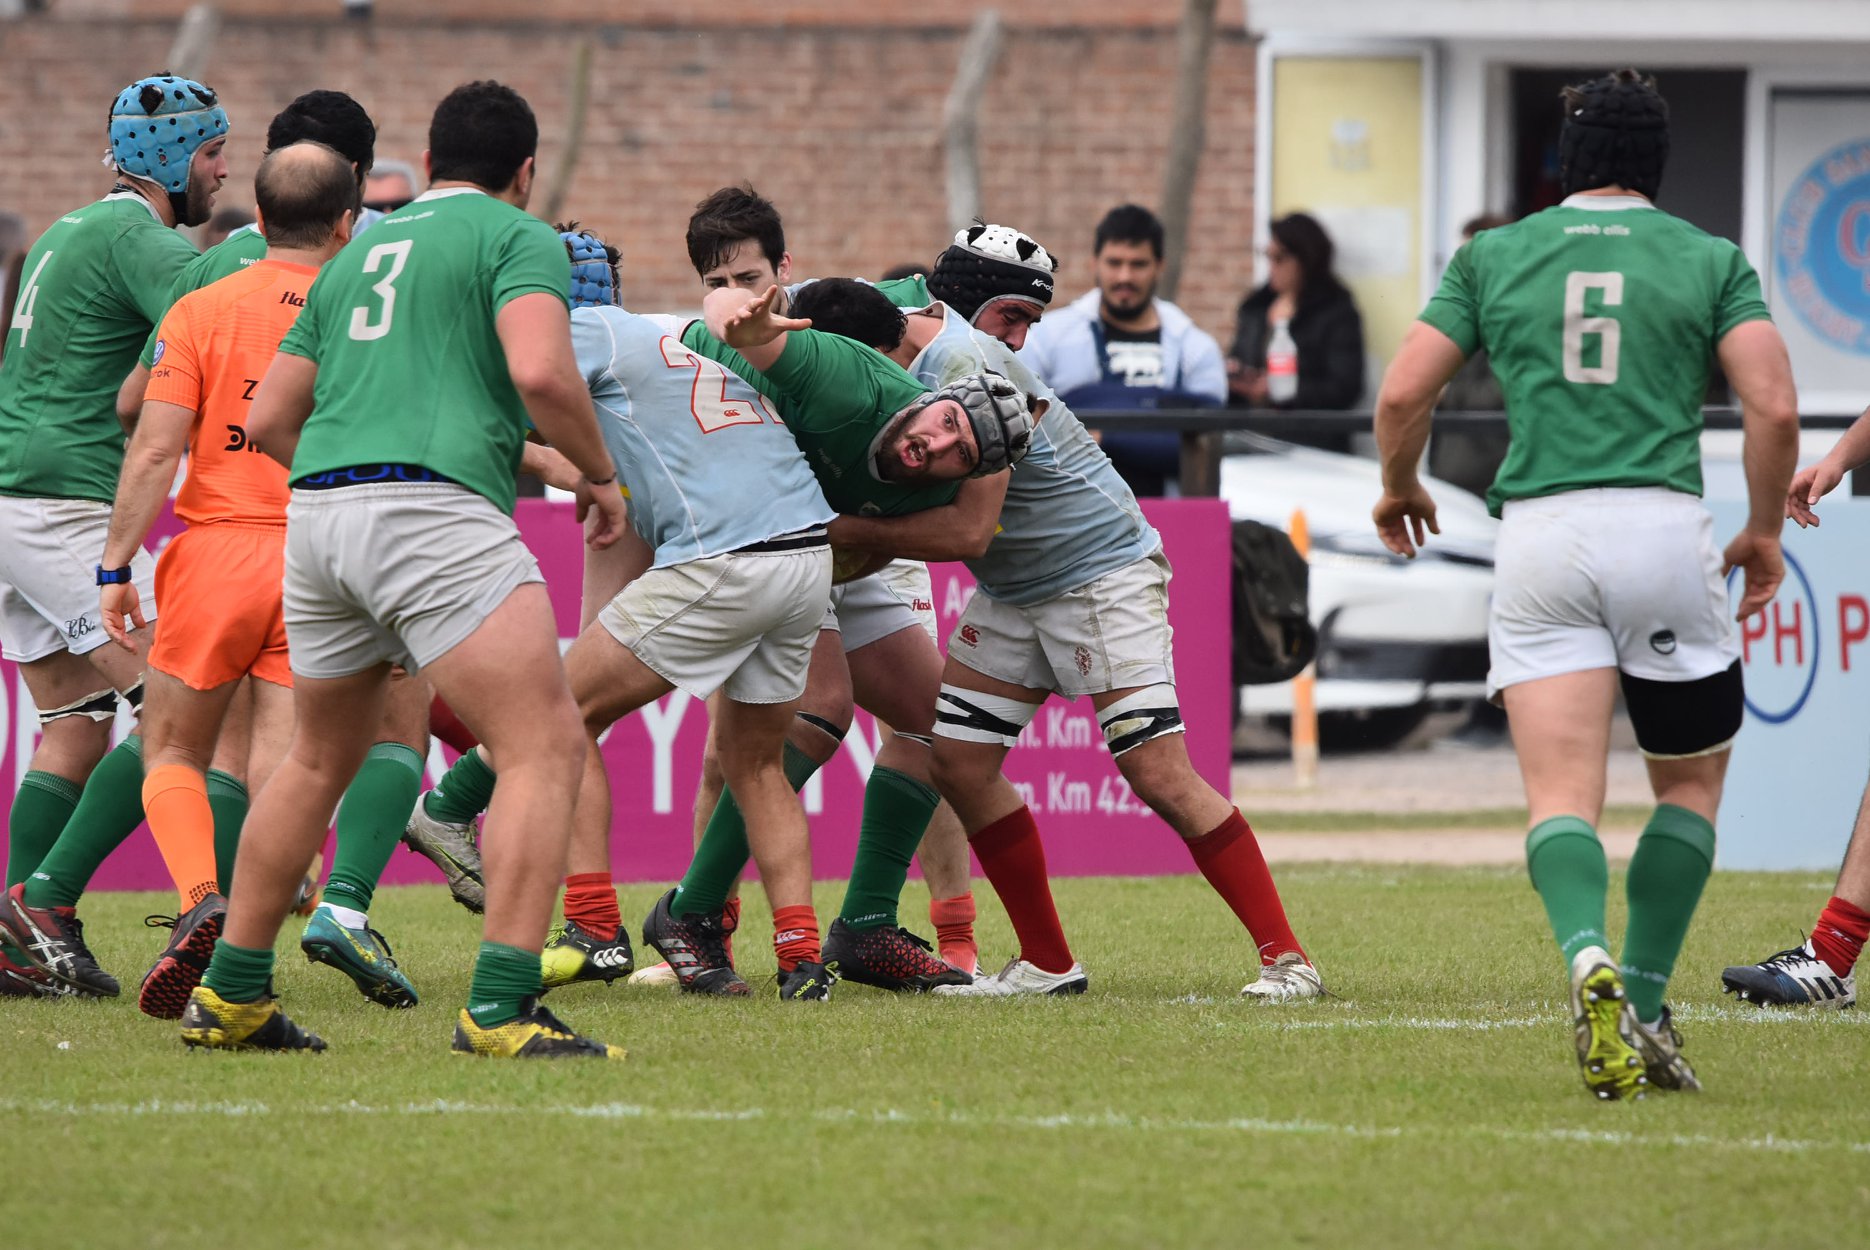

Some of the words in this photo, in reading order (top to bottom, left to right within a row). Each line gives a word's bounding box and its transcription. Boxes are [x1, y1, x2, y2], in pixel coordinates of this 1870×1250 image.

[11, 250, 54, 348] 4
[279, 290, 305, 307] fla
[348, 239, 413, 341] 3
[1563, 271, 1624, 384] 6
[241, 378, 259, 400] Z
[659, 335, 785, 434] 2
[1741, 600, 1804, 666] PH
[1046, 706, 1092, 748] Km
[1046, 771, 1092, 813] Km
